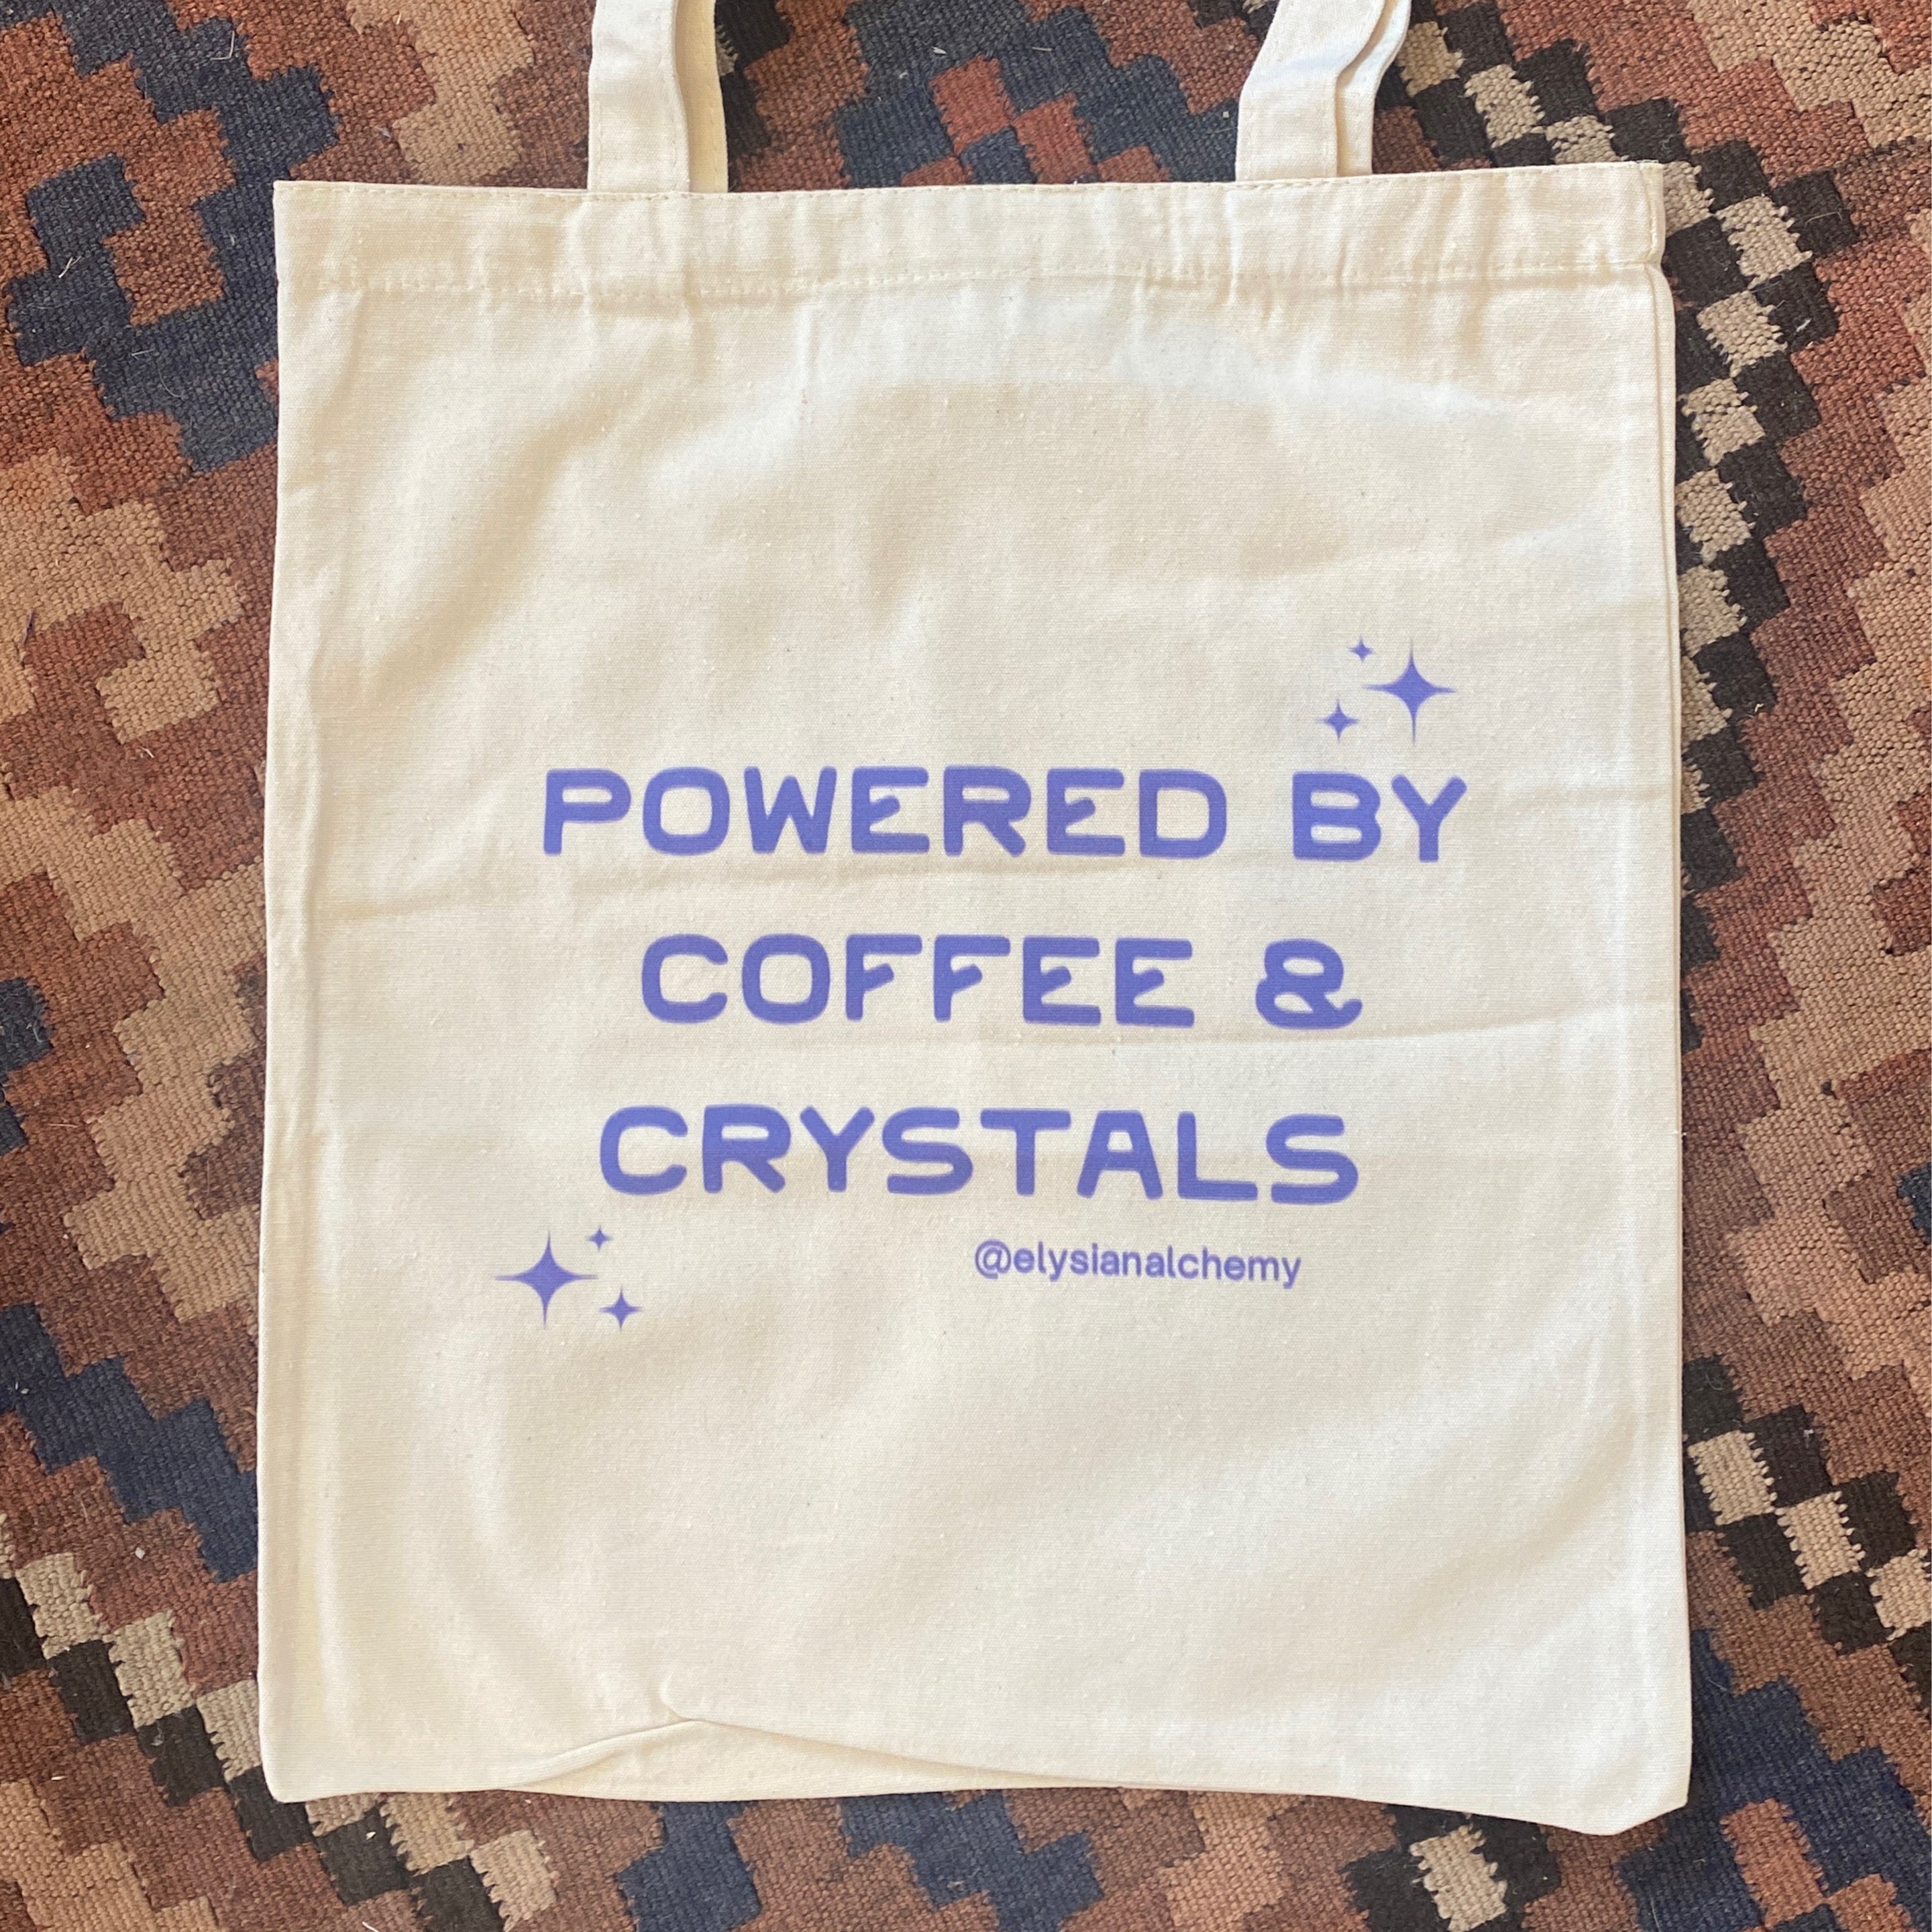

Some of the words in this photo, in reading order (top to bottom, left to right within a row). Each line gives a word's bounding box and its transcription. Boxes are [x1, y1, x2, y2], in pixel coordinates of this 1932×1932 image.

[542, 764, 1229, 860] POWERED
[1291, 769, 1468, 863] BY
[640, 932, 1195, 1028] COFFEE
[1253, 937, 1364, 1031] &
[598, 1102, 1360, 1206] CRYSTALS
[974, 1238, 1302, 1290] @elysianalchemy
